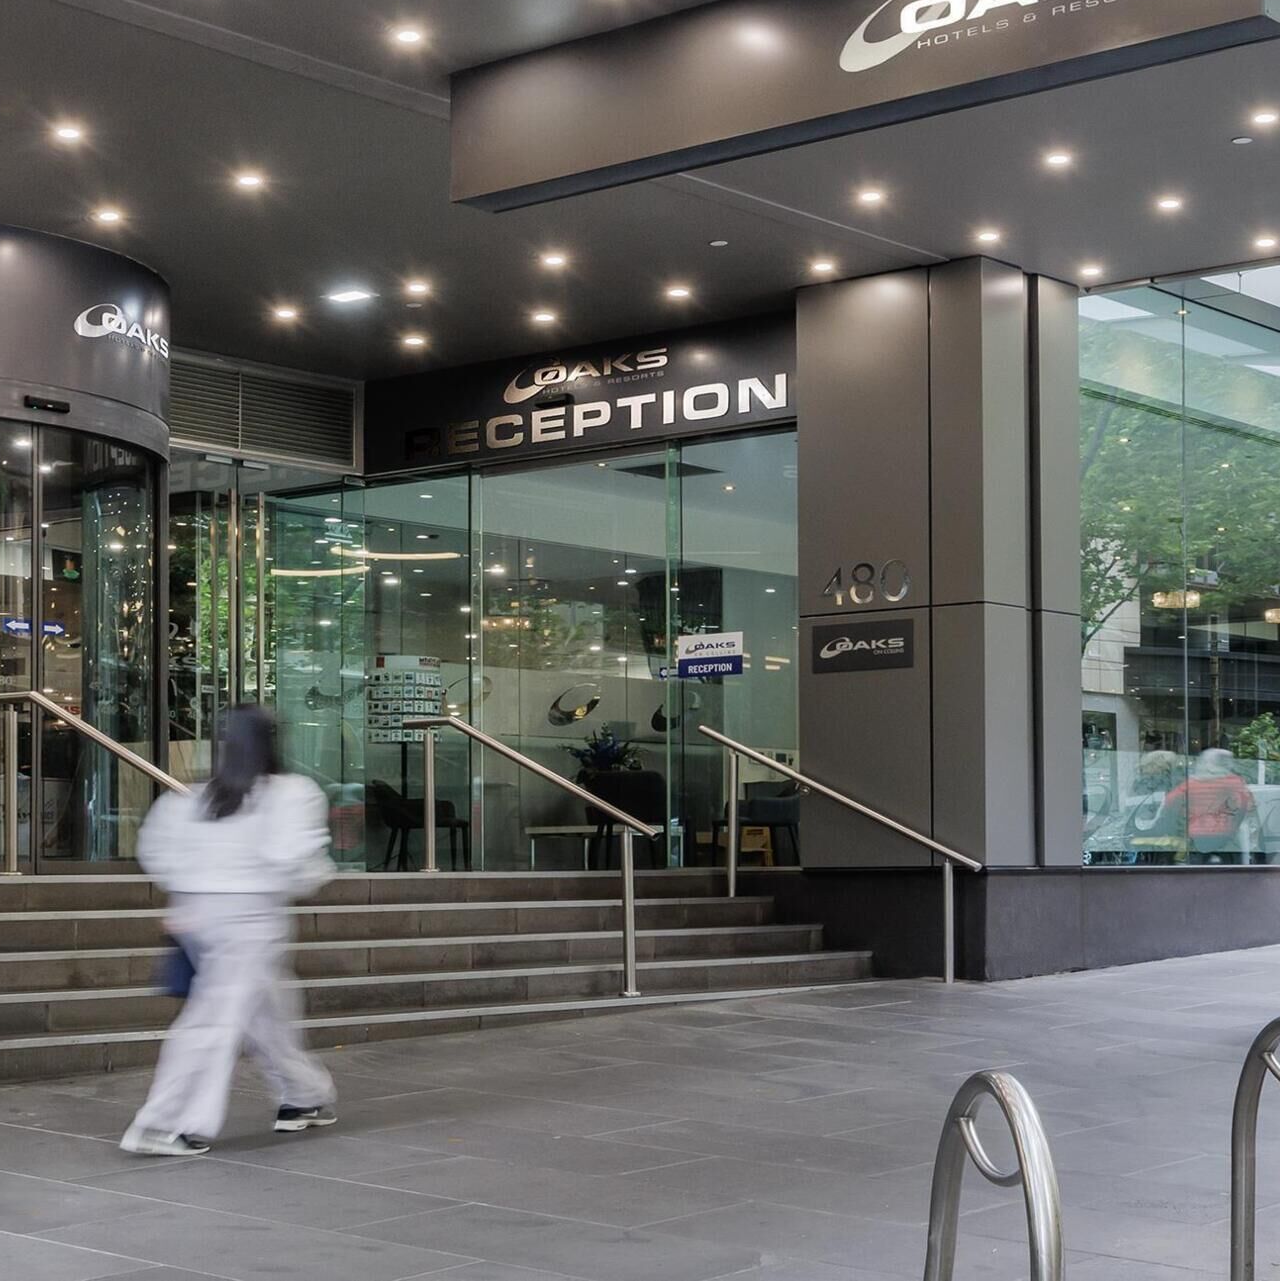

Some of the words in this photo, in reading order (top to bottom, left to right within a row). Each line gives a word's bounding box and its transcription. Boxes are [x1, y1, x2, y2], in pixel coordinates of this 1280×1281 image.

[917, 18, 1009, 50] HOTELS
[1022, 12, 1037, 24] &
[101, 312, 169, 359] OAKS
[534, 346, 669, 386] OAKS
[404, 372, 788, 459] RECEPTION
[820, 559, 912, 607] 480
[694, 641, 736, 650] OAKS
[836, 637, 905, 652] OAKS
[688, 662, 733, 675] RECEPTION
